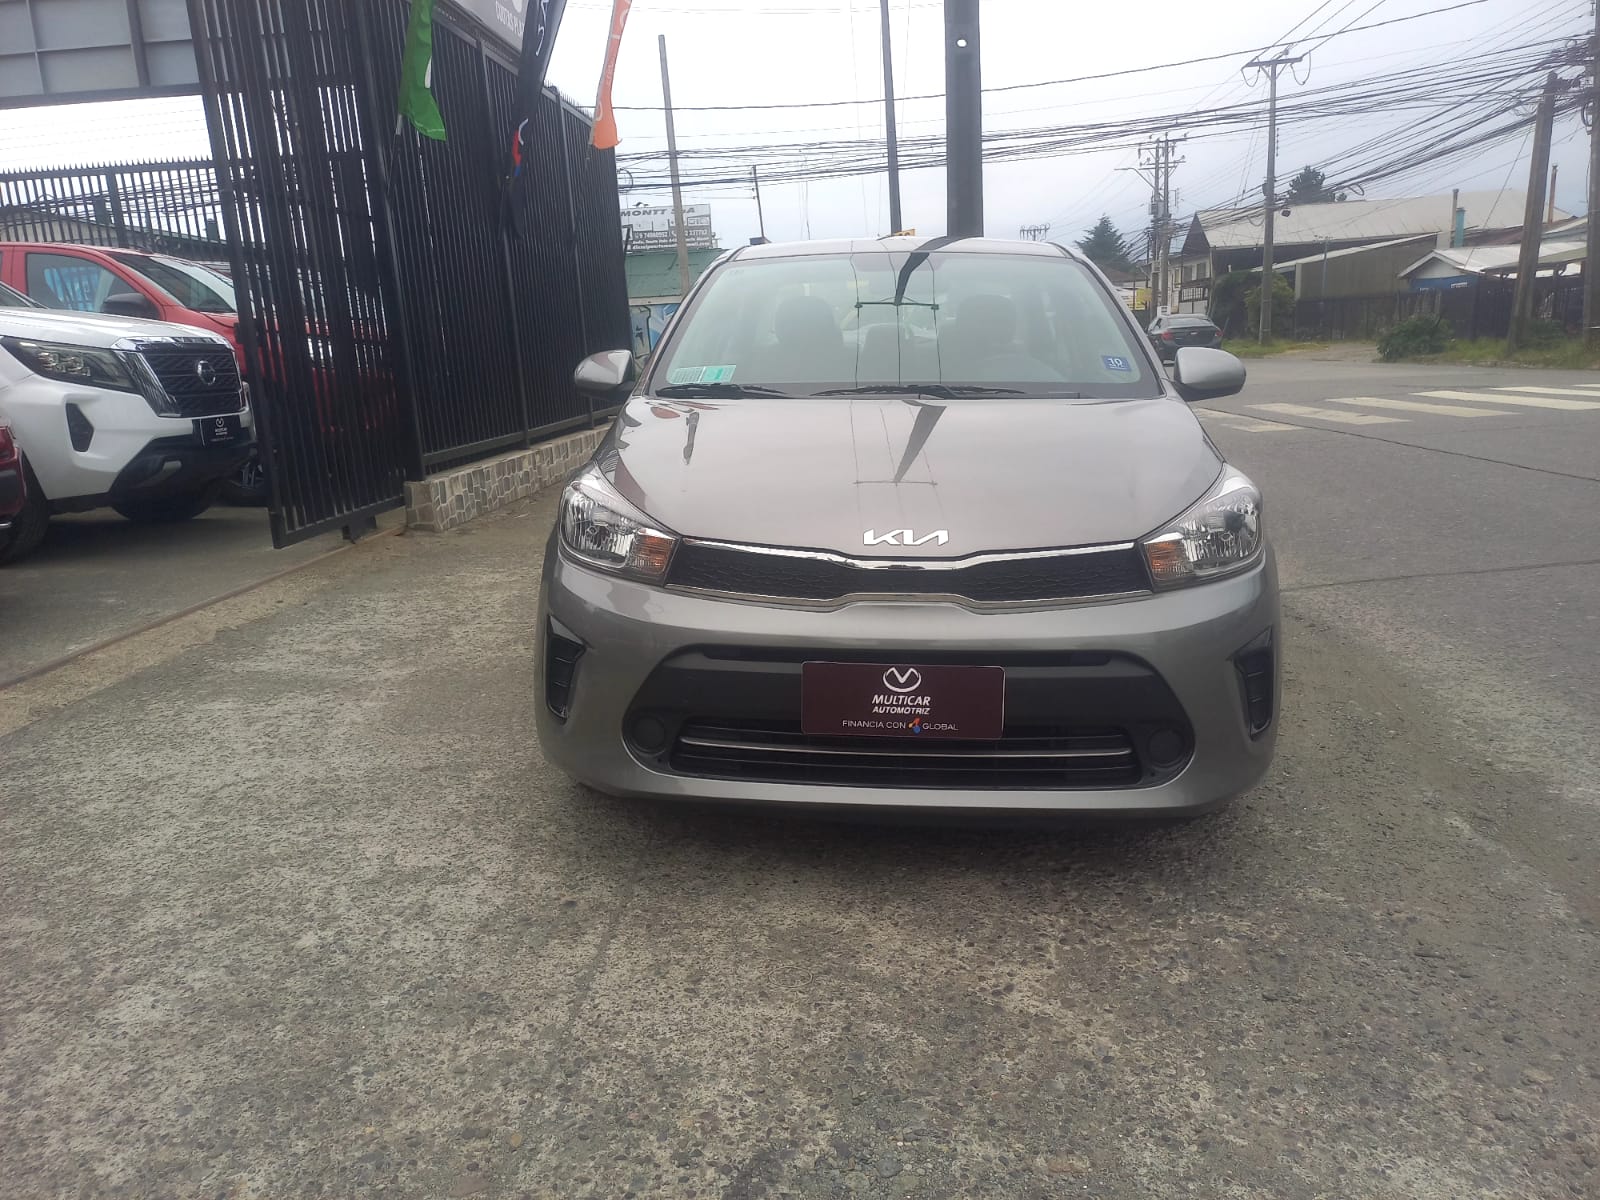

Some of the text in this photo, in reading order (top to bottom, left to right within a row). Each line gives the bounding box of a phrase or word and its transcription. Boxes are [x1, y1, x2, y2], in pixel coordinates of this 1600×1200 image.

[863, 529, 949, 546] KIA
[872, 694, 931, 706] MULTICAR
[872, 706, 931, 715] AUTOMOTRIZ
[842, 719, 959, 731] FINANCIA CON GLOBAL
